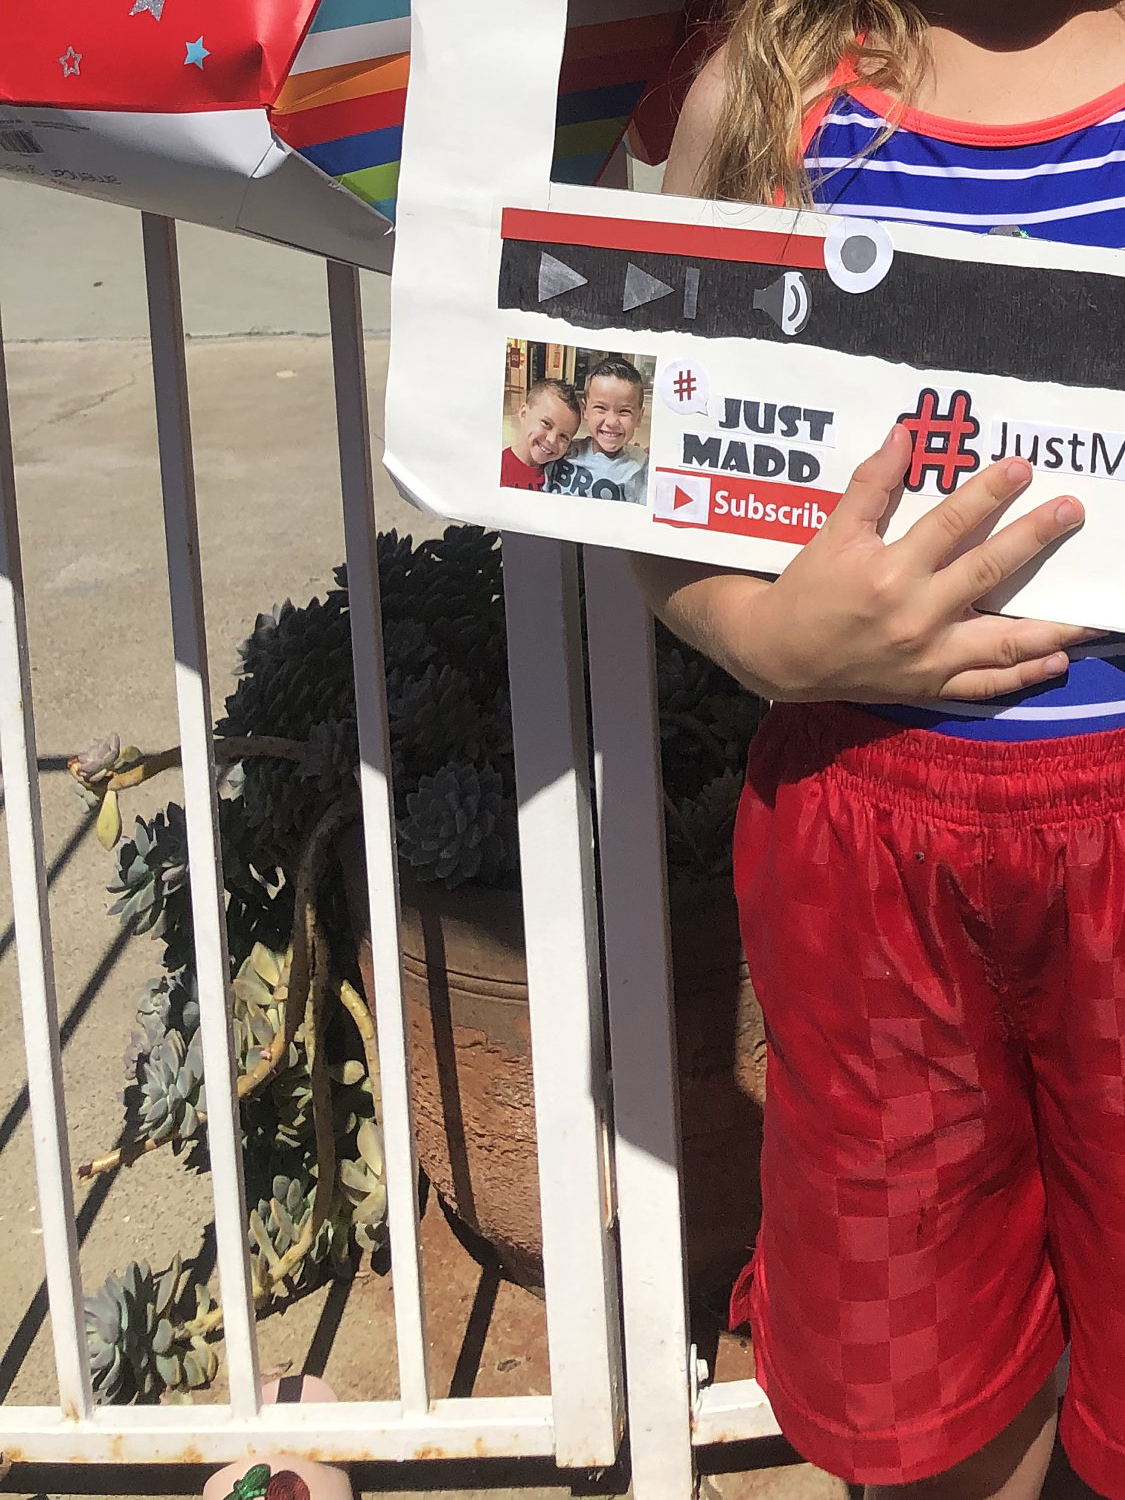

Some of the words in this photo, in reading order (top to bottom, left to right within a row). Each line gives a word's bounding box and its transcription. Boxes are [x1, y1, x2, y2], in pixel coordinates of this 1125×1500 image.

[718, 397, 834, 442] JUST
[683, 433, 821, 483] MADD
[714, 490, 828, 530] Subscrib
